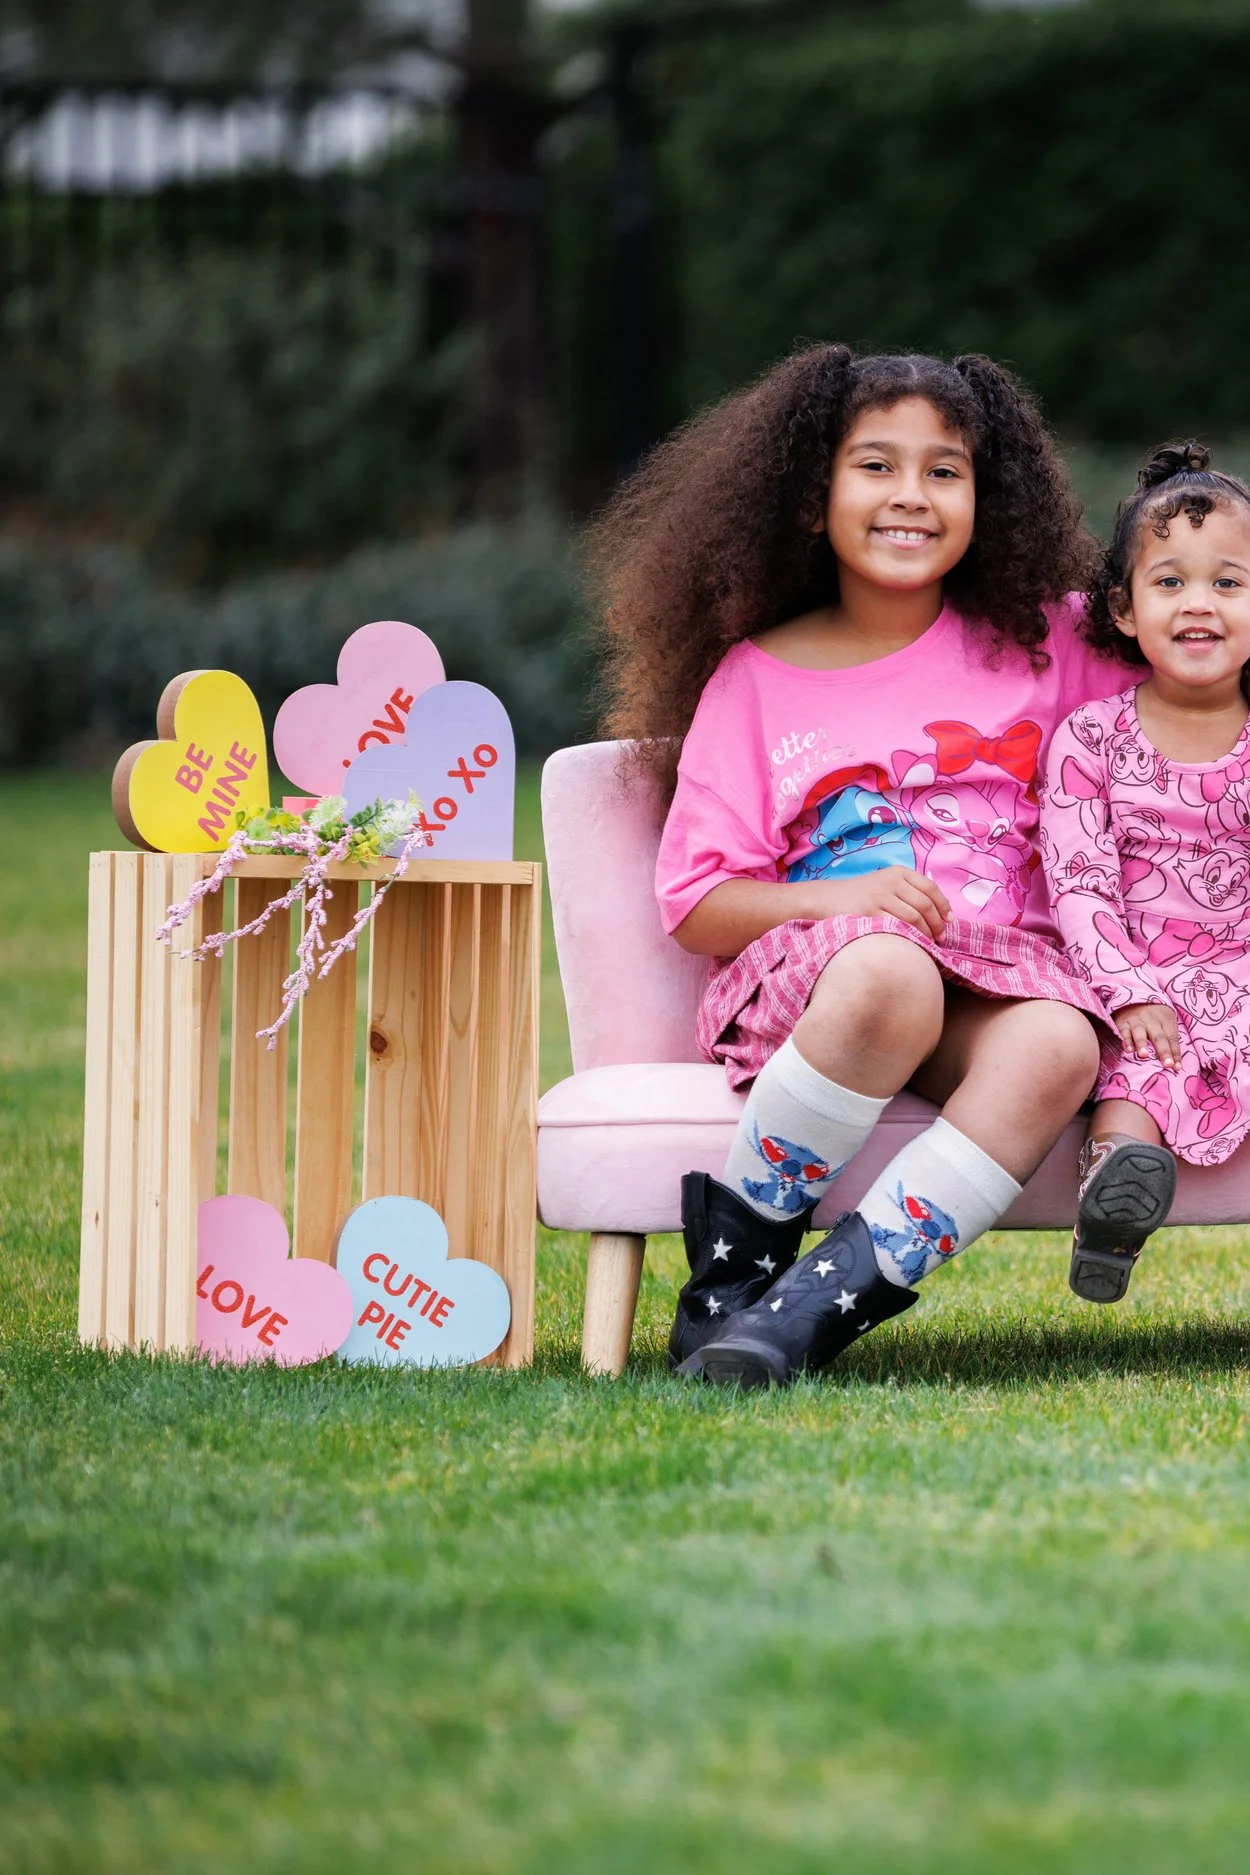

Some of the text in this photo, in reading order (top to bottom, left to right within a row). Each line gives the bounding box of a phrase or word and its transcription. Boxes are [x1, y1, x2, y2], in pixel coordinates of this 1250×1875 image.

[343, 687, 414, 768] OVE
[174, 742, 214, 794] BE
[197, 741, 257, 842] MINE
[196, 1264, 289, 1347] LOVE
[356, 1300, 412, 1350] PIE
[363, 1252, 455, 1328] CUTIE
